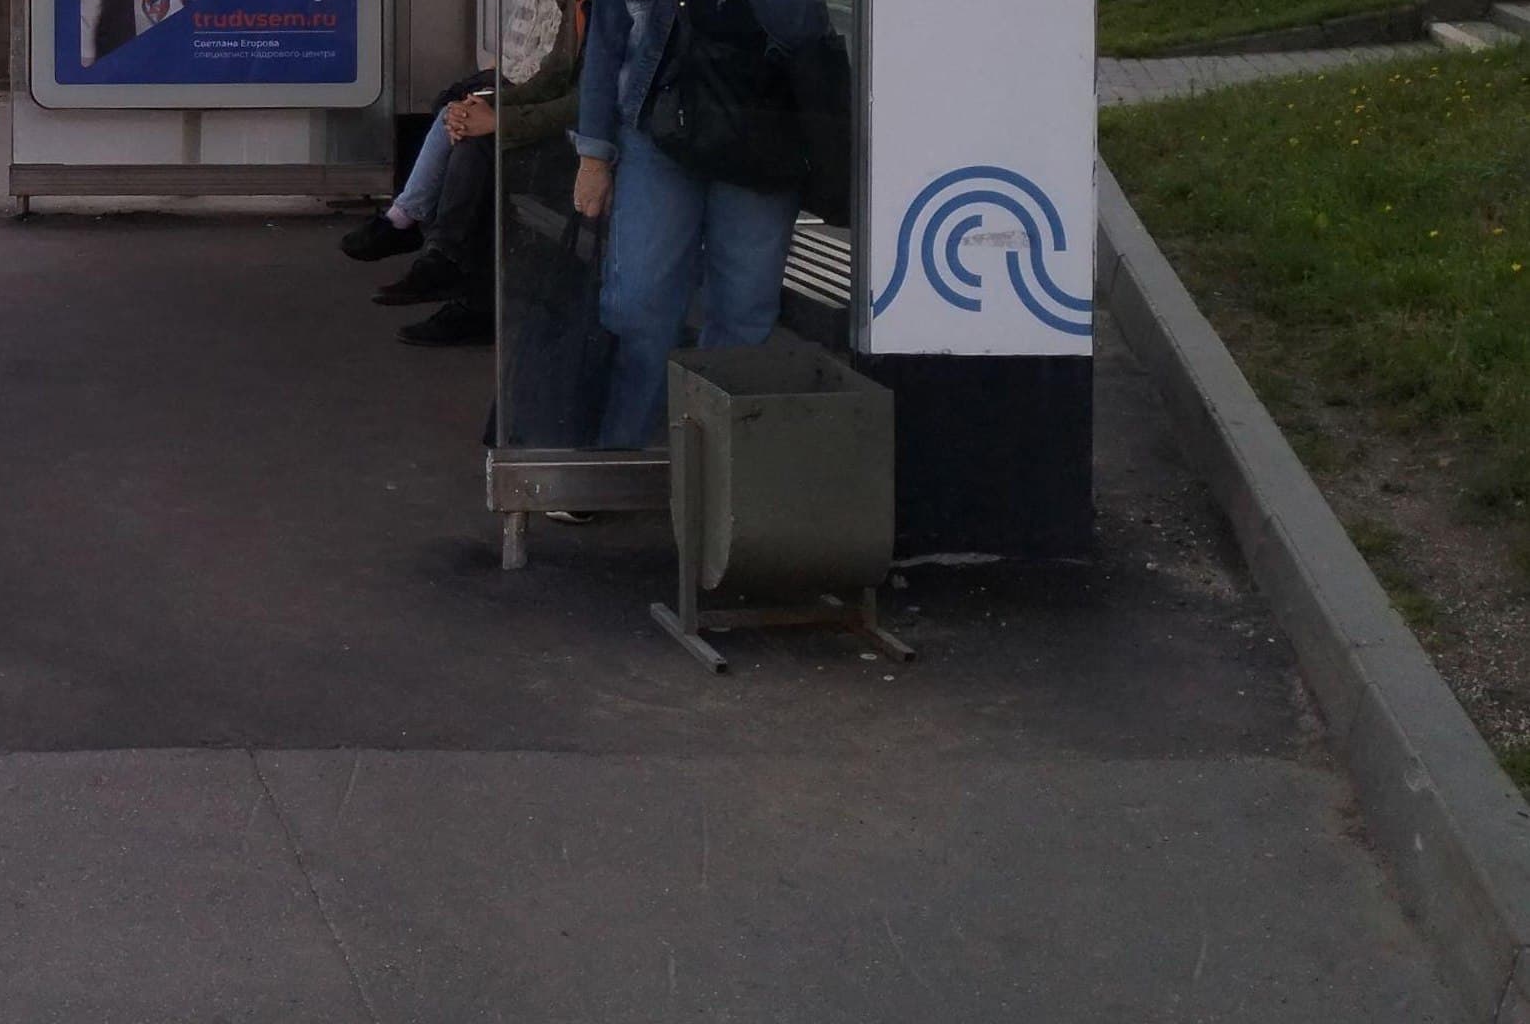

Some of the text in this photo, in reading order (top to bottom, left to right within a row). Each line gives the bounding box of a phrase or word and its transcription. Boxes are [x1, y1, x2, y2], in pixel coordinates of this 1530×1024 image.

[193, 9, 337, 28] trudvsem.ru
[193, 39, 280, 49] Светлана Егорова
